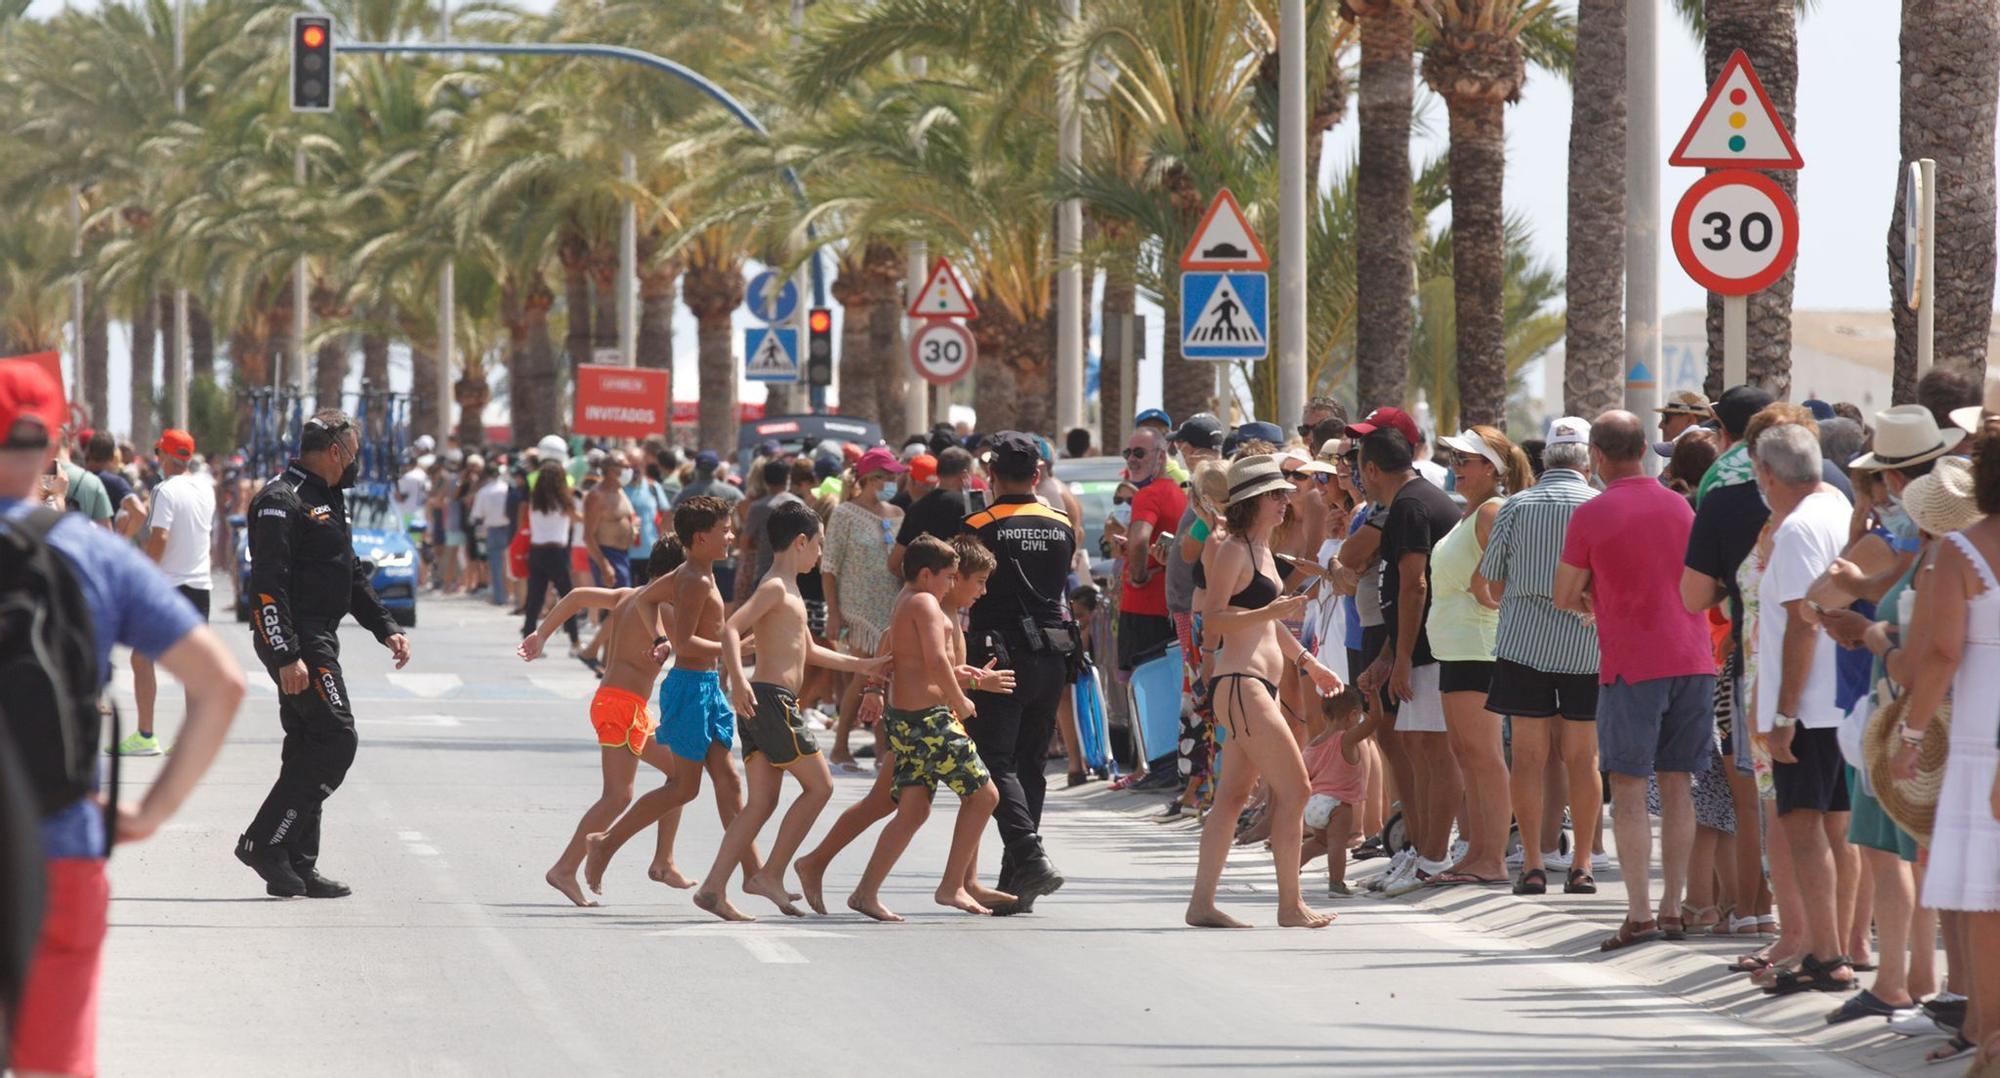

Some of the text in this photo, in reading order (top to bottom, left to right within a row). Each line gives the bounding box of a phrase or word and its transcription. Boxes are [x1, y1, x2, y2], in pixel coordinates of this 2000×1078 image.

[1702, 211, 1773, 252] 30
[925, 340, 961, 363] 30
[585, 404, 656, 424] INVITADOS
[997, 527, 1066, 541] PROTECCIÓN
[1021, 540, 1048, 551] CIVIL
[262, 604, 289, 652] caser
[322, 673, 343, 707] caser
